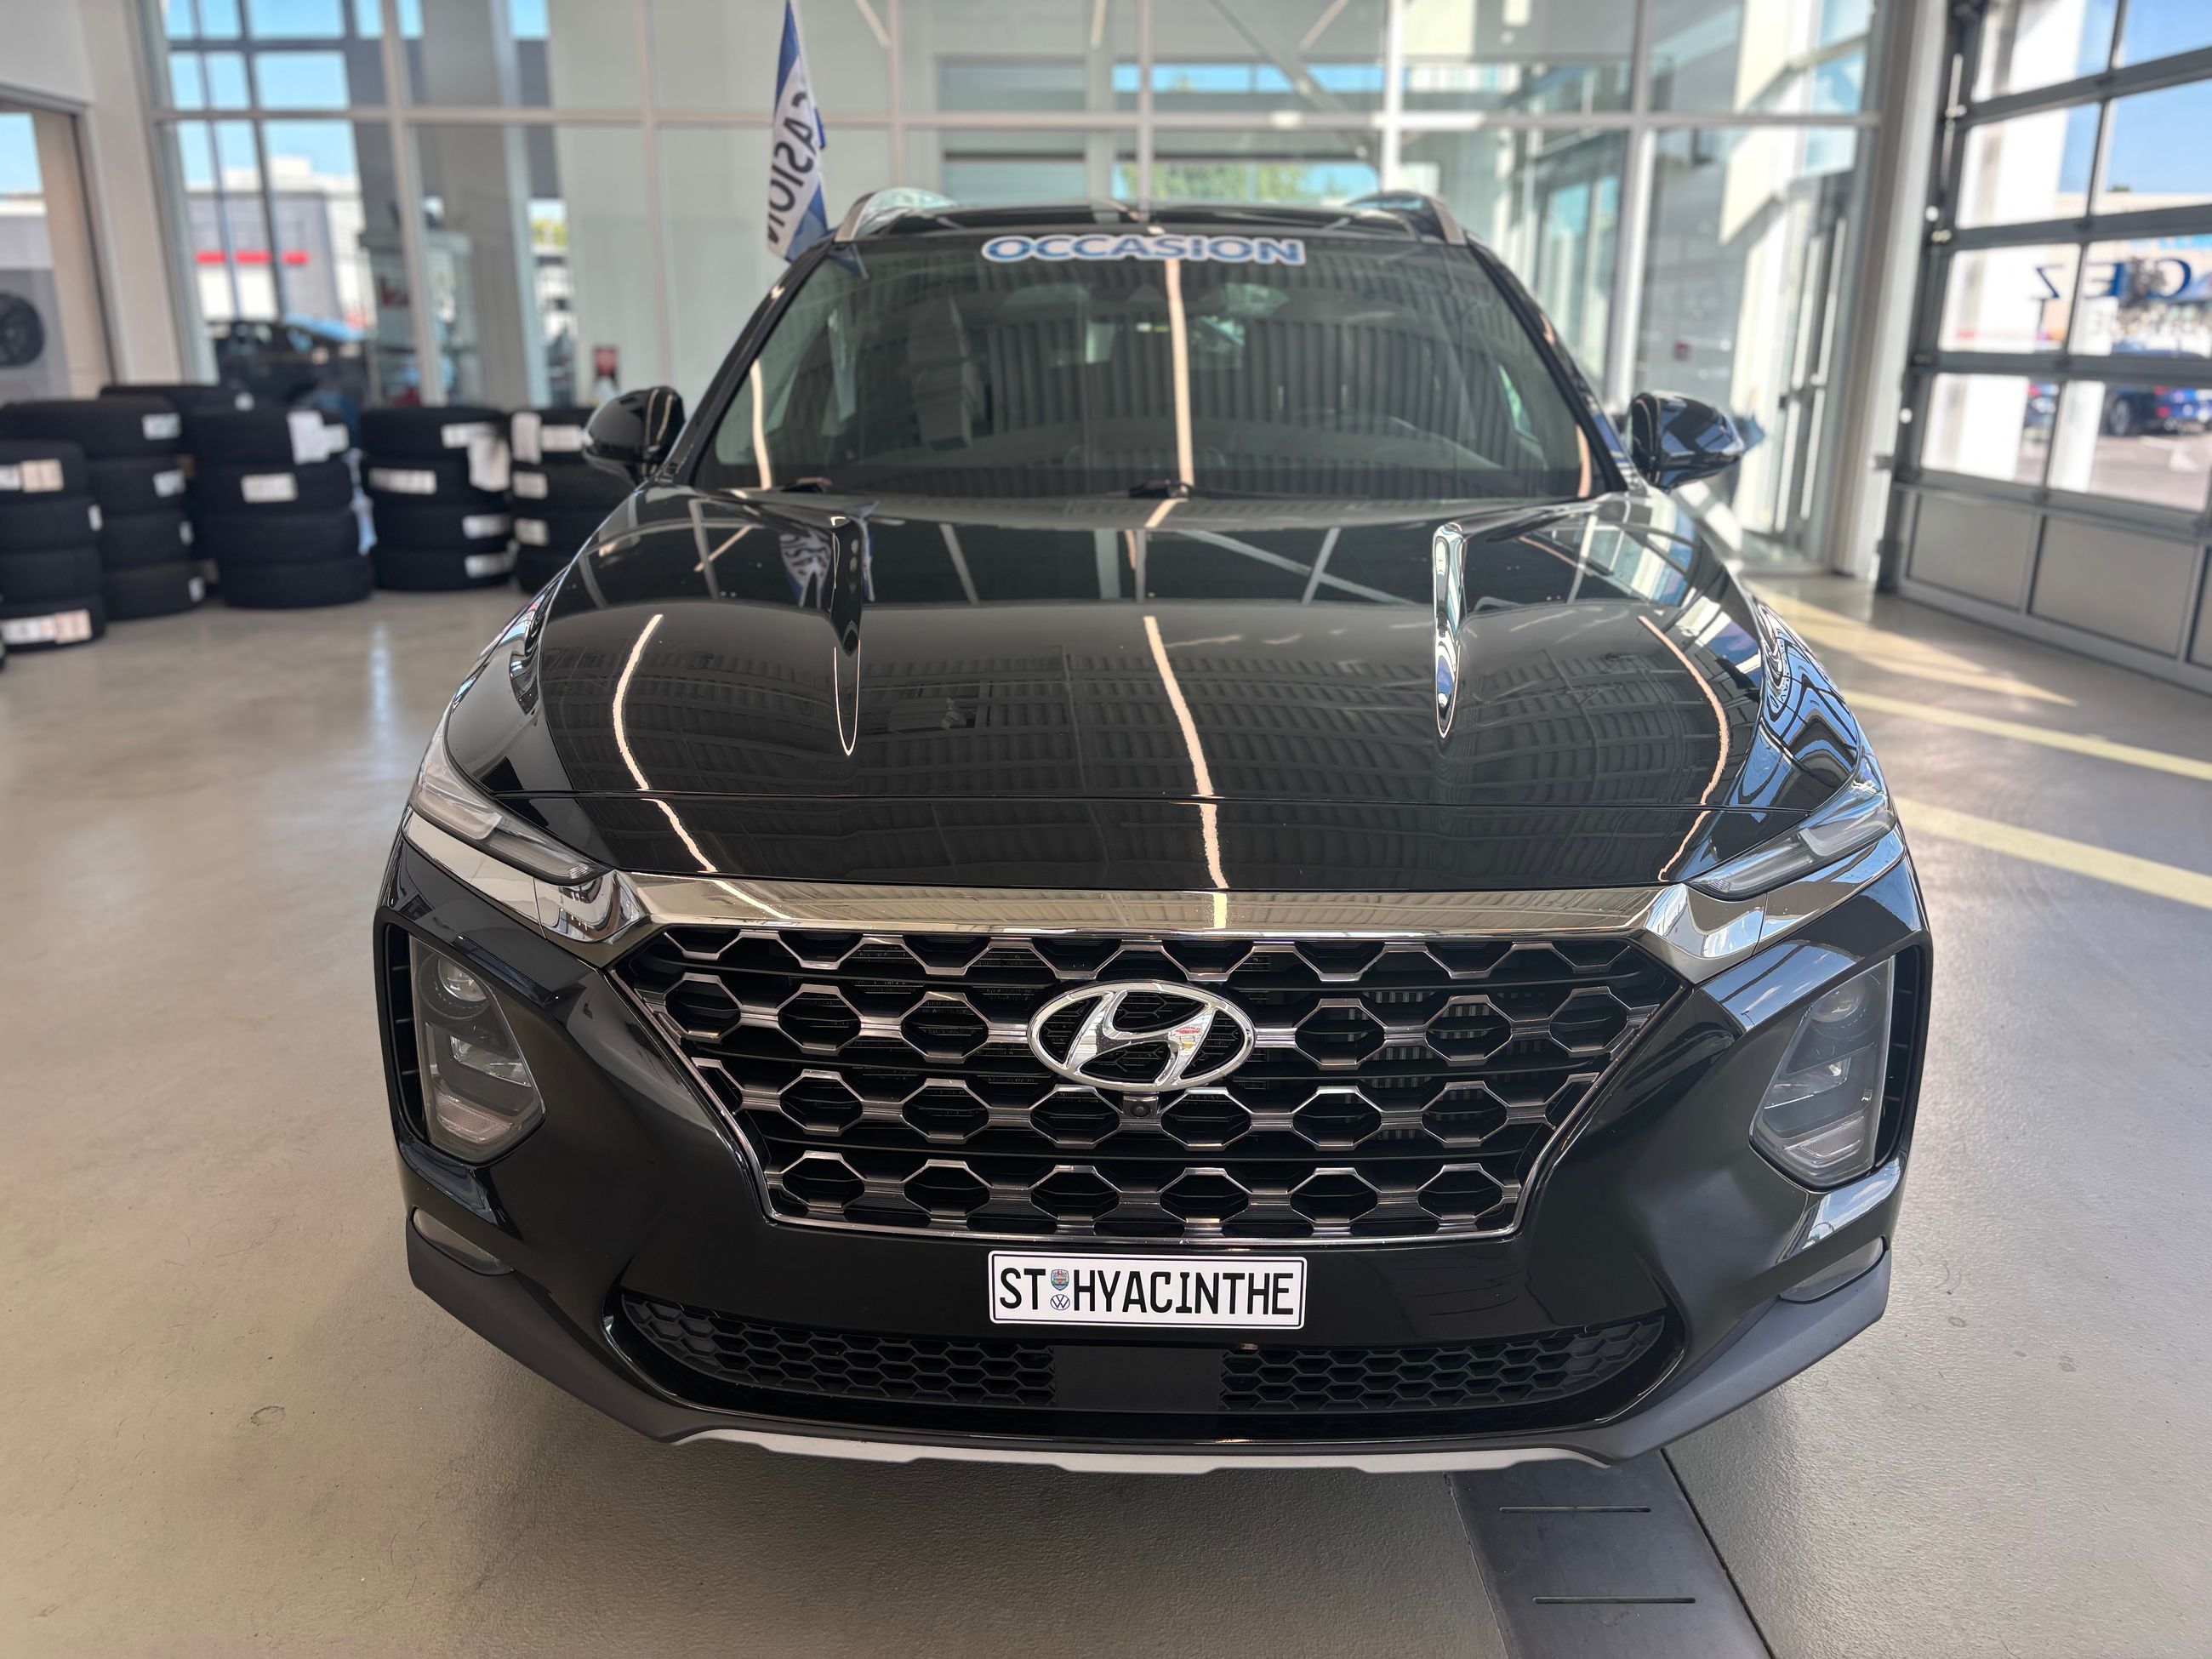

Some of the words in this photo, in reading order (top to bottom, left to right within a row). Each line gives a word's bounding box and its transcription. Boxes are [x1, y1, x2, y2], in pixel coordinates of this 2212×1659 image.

[985, 236, 1302, 263] OCCASION
[1000, 1268, 1046, 1310] ST
[1074, 1269, 1294, 1315] HYACINTHE
